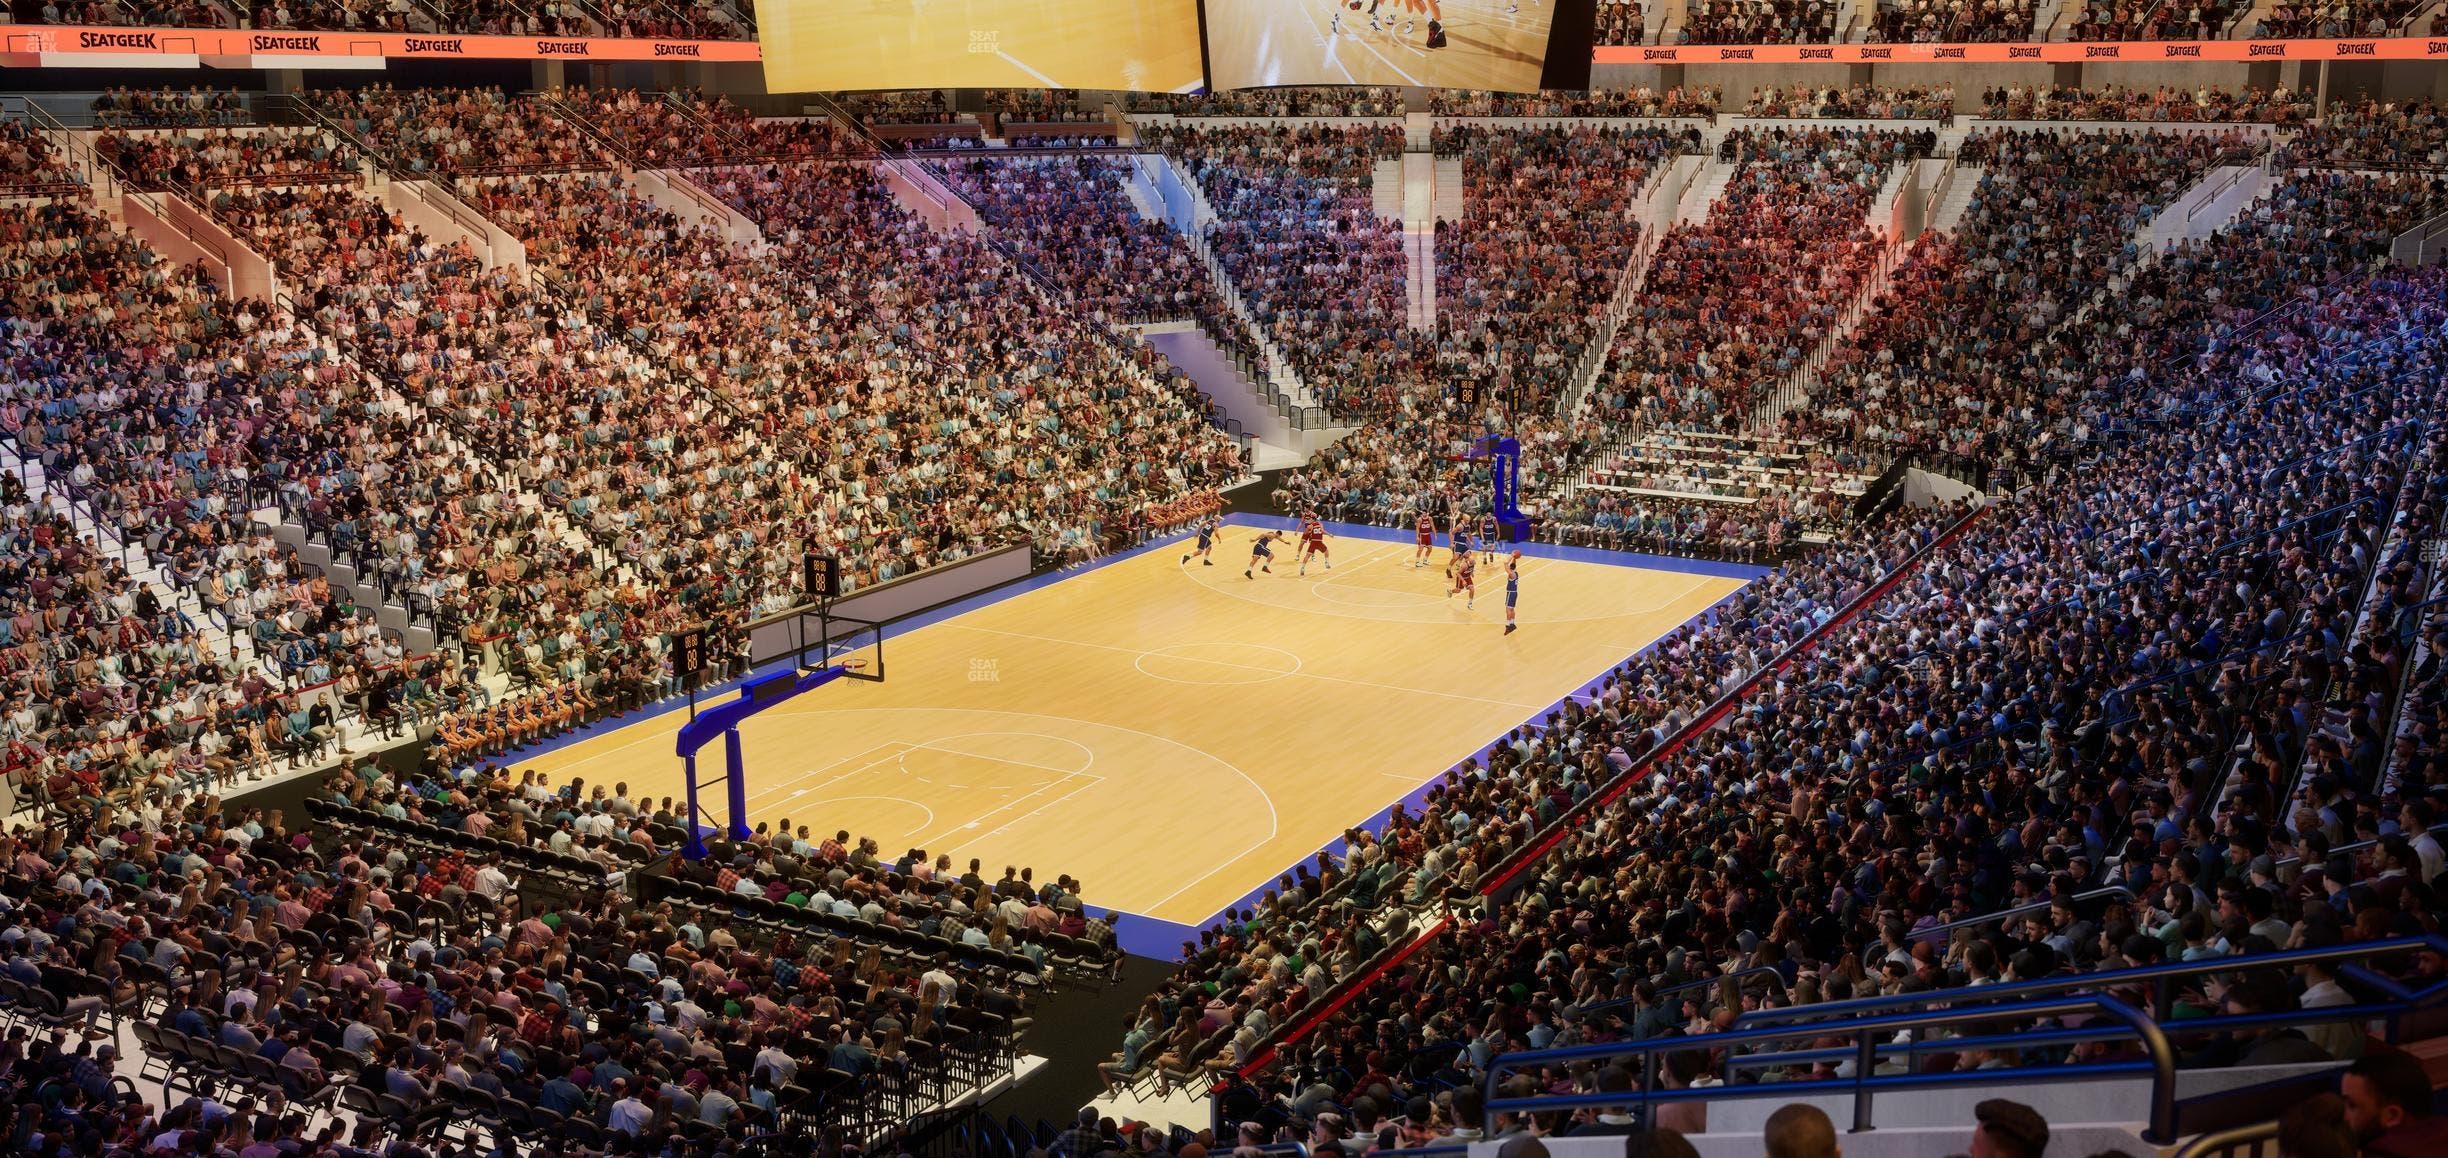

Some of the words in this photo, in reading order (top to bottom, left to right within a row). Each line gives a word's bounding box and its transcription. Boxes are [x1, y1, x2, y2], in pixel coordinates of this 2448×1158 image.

[80, 32, 157, 49] SEATGEEK
[253, 36, 320, 52] SEATGEEK
[405, 39, 463, 53] SEATGEEK
[537, 41, 588, 55] SEATGEEK
[655, 43, 699, 56] SEATGEEK
[1721, 49, 1753, 59] SEATGEEK
[1800, 48, 1833, 59] SEATGEEK
[1861, 48, 1891, 59] SEATGEEK
[1934, 48, 1965, 58] SEATGEEK
[2009, 47, 2042, 58] SEATGEEK
[2086, 46, 2119, 57] SEATGEEK
[2166, 45, 2201, 57] SEATGEEK
[2249, 44, 2286, 56] SEATGEEK
[2337, 43, 2376, 55] SEATGEEK
[1644, 49, 1677, 60] SEATGEEK
